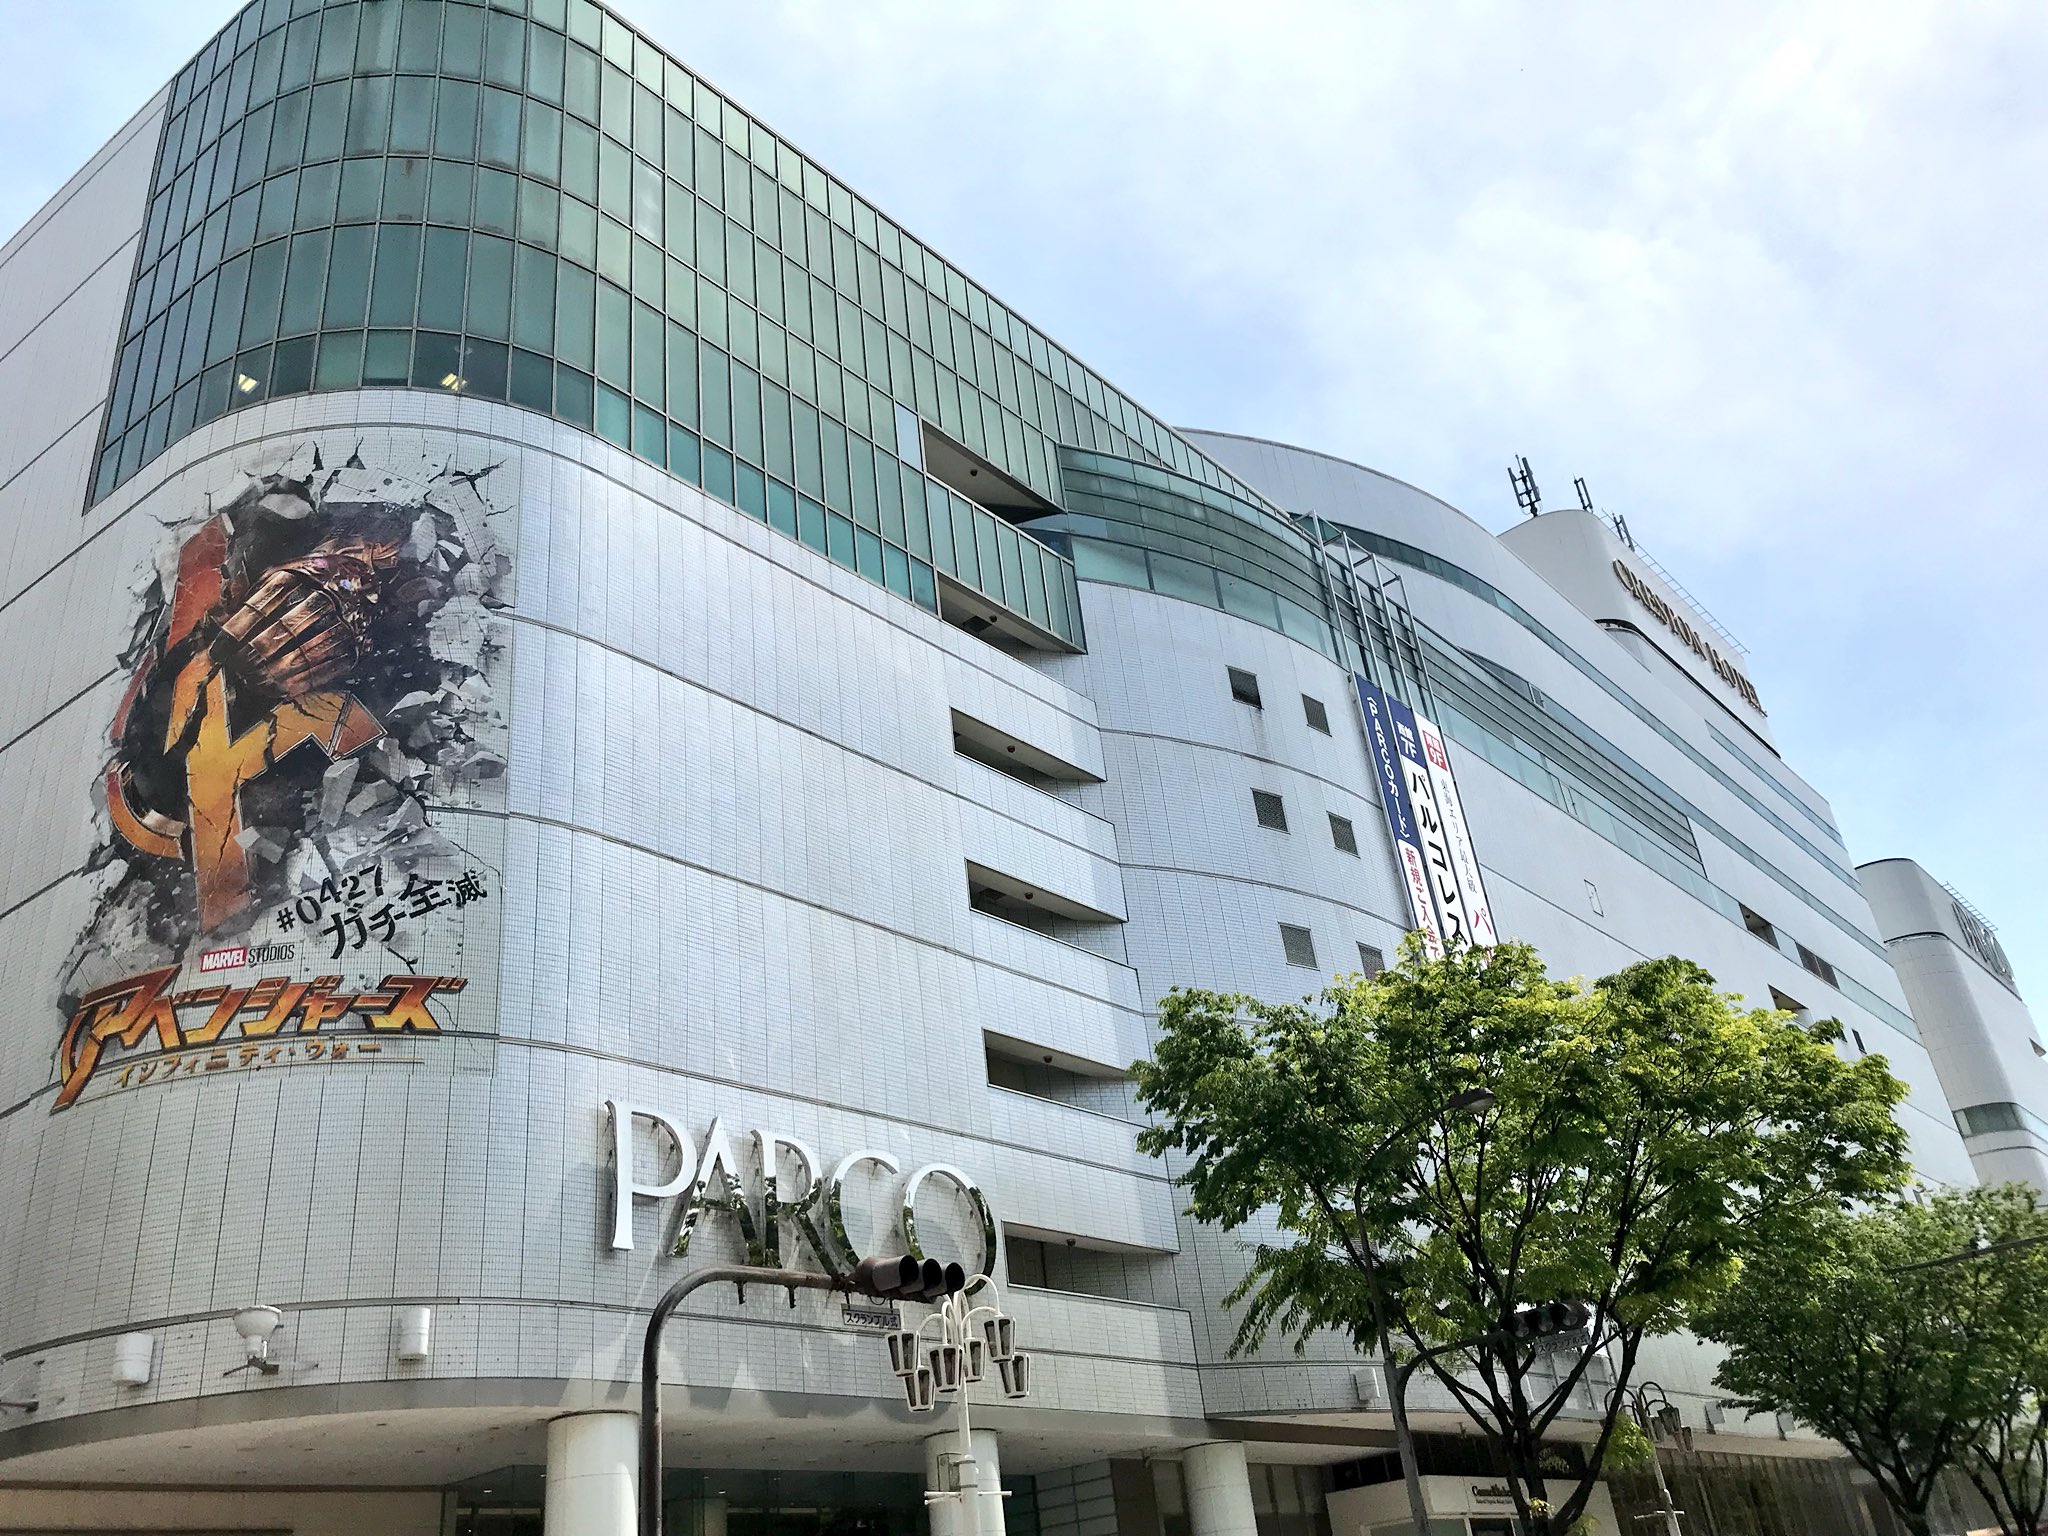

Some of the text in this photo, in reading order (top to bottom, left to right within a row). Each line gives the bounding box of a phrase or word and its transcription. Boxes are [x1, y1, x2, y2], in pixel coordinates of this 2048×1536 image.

[276, 863, 385, 933] #0427
[322, 868, 488, 959] ガチ全滅
[201, 944, 295, 972] MARVEL STUDIOS
[50, 964, 468, 1115] アベンジャーズ
[604, 1099, 998, 1295] PARCO
[846, 1312, 898, 1328] スクランブル式
